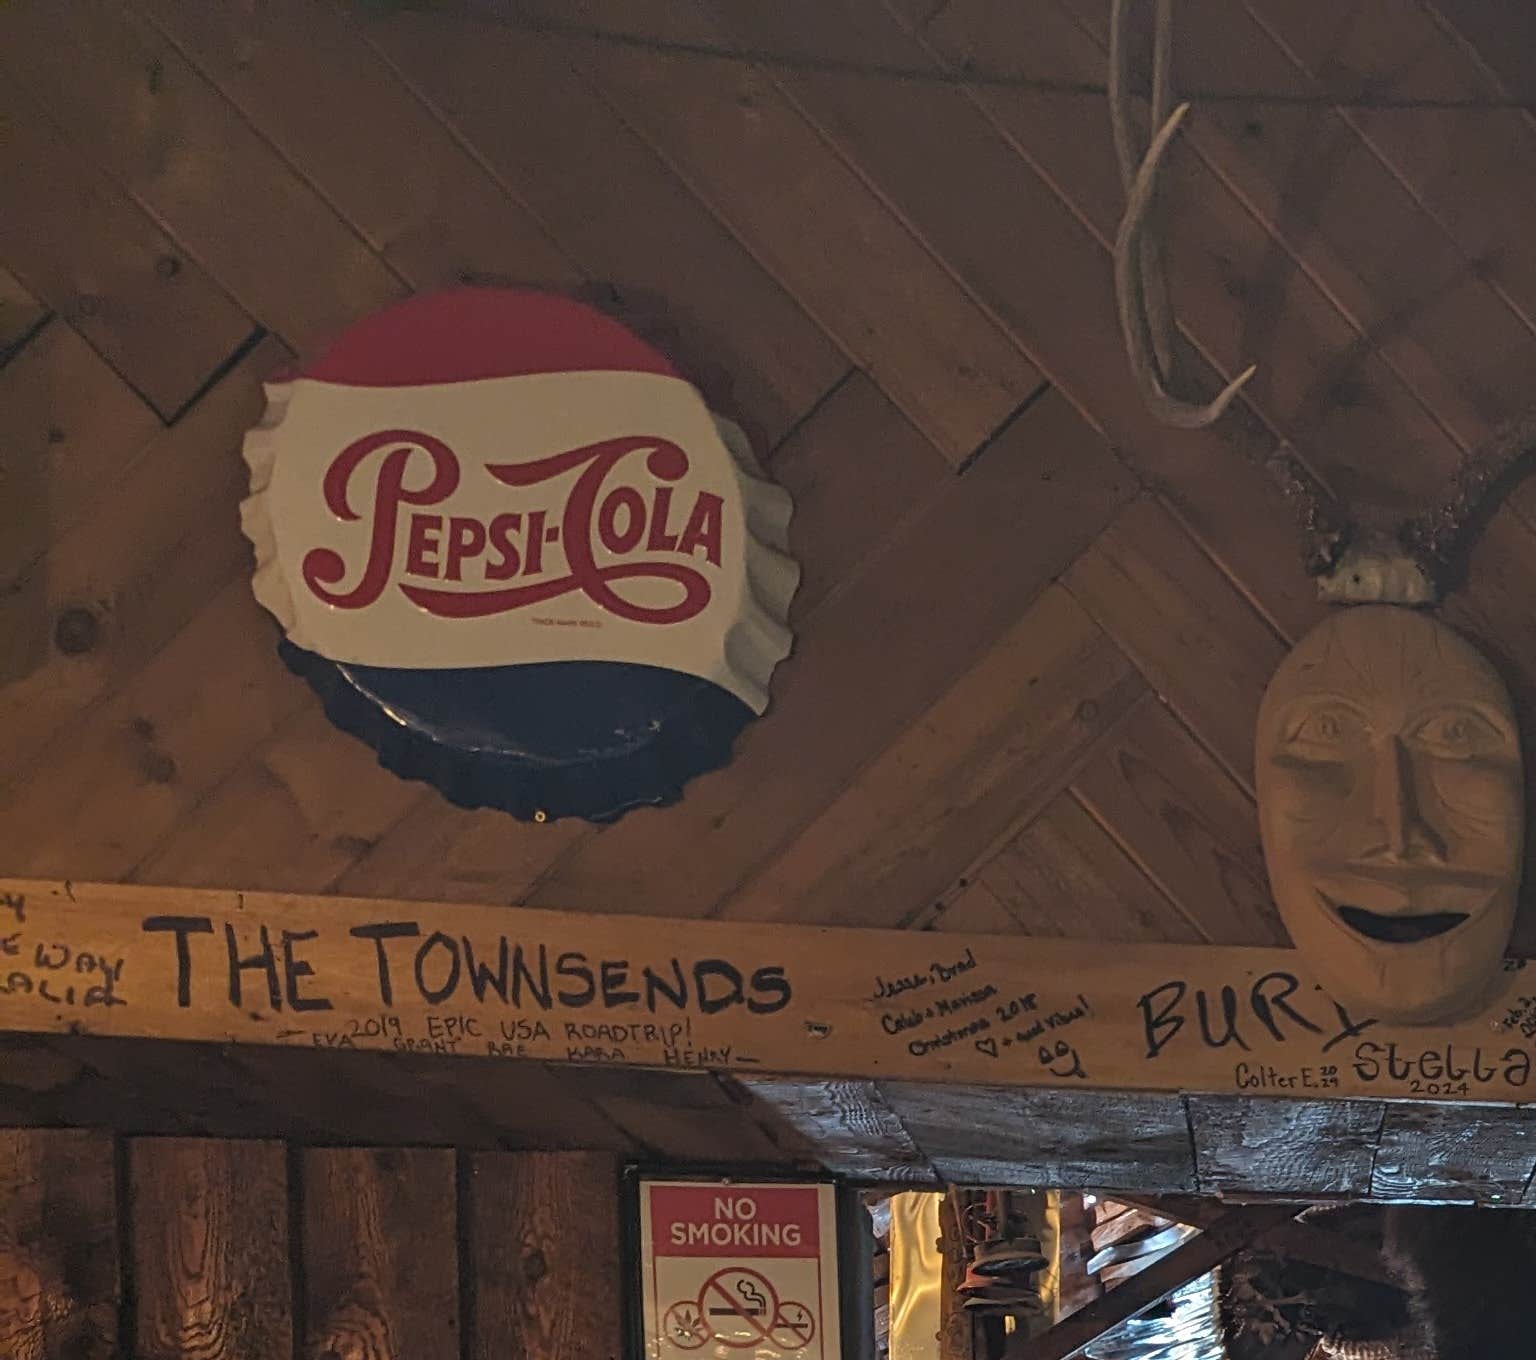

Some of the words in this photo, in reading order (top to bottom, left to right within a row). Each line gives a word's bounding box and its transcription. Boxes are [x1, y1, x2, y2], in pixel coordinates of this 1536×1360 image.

[143, 914, 332, 1014] THE
[349, 921, 793, 1017] TOWNSENDS
[350, 1016, 402, 1038] 2019
[427, 1016, 483, 1039] EPIC
[500, 1019, 550, 1041] USA
[714, 1197, 757, 1220] NO
[670, 1222, 802, 1246] SMOKING
